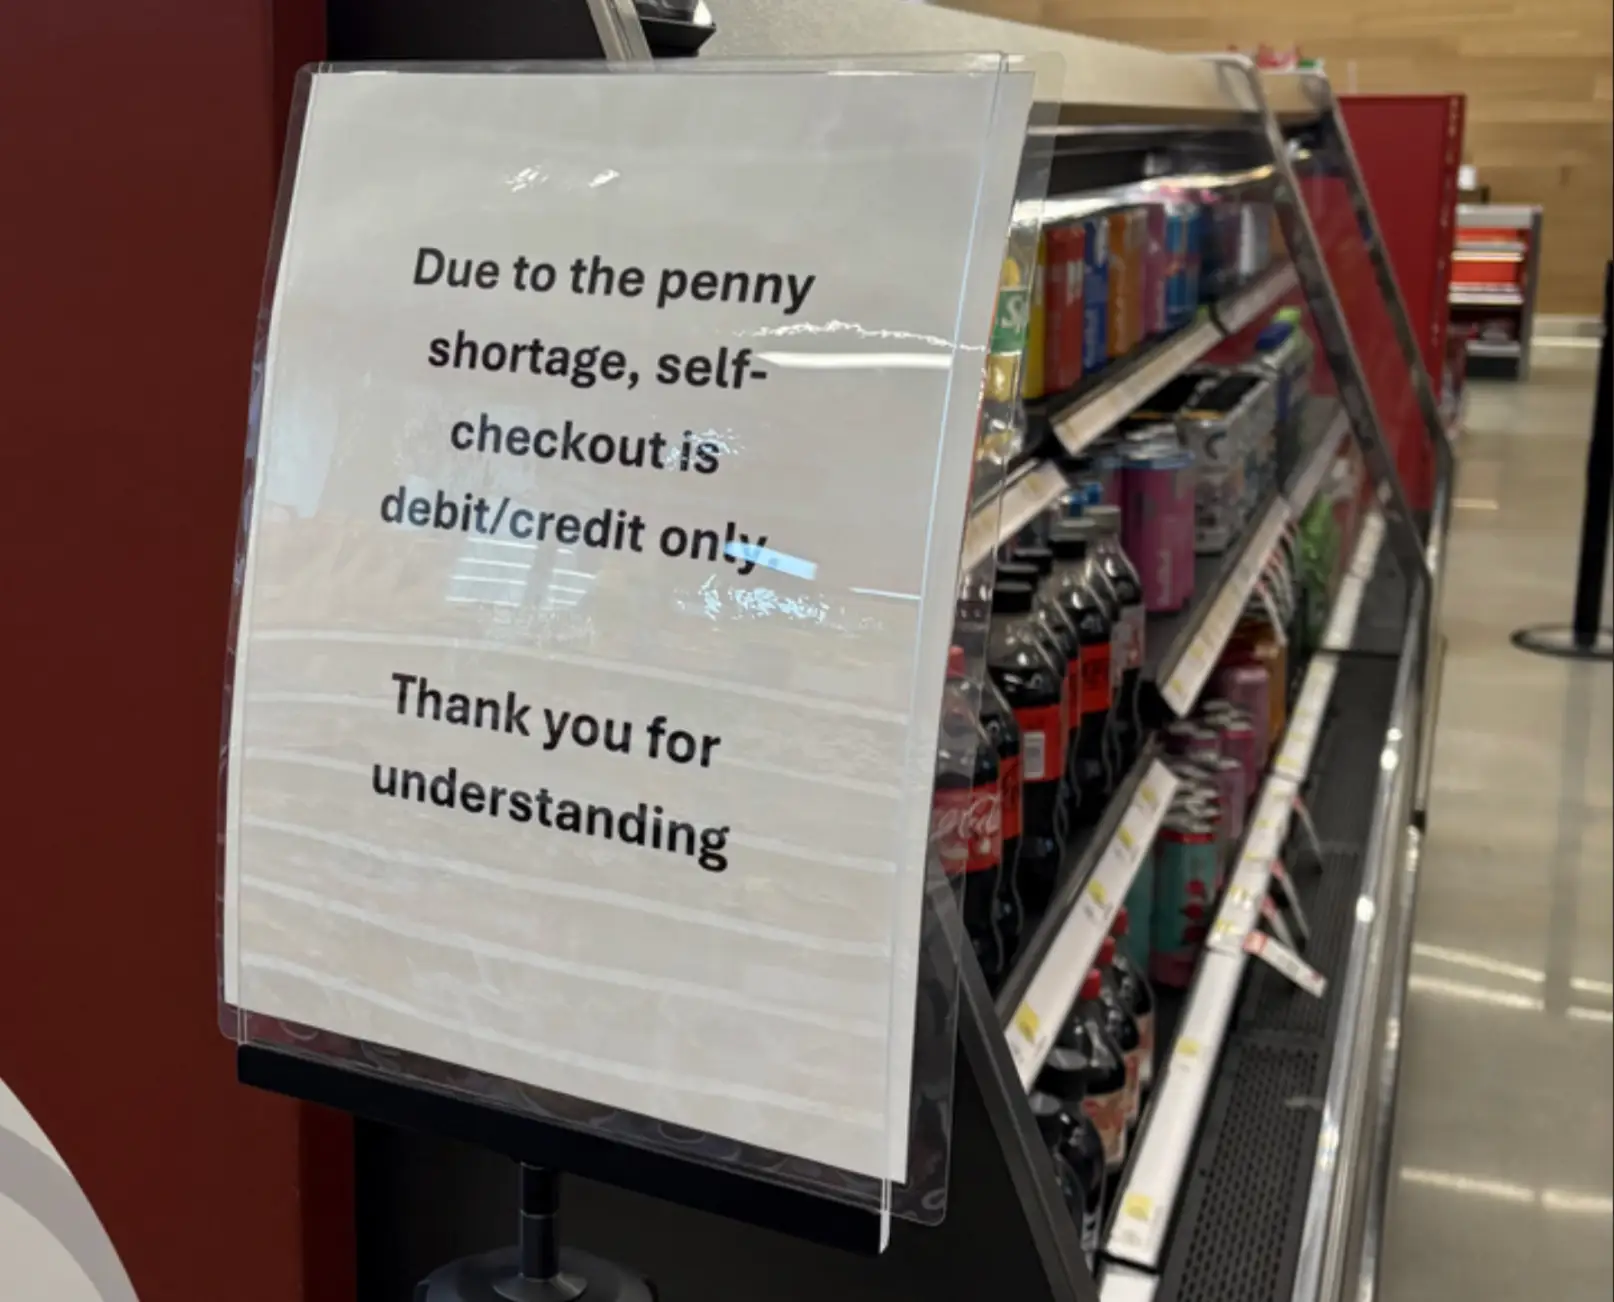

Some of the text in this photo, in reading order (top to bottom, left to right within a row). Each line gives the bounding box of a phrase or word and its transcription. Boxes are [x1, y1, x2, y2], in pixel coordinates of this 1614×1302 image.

[413, 247, 817, 316] Due to the penny
[427, 329, 768, 391] shortage, self-
[450, 412, 721, 475] checkout is
[379, 485, 646, 553] debit/credit
[391, 672, 722, 769] Thank you for
[372, 763, 731, 873] understanding
